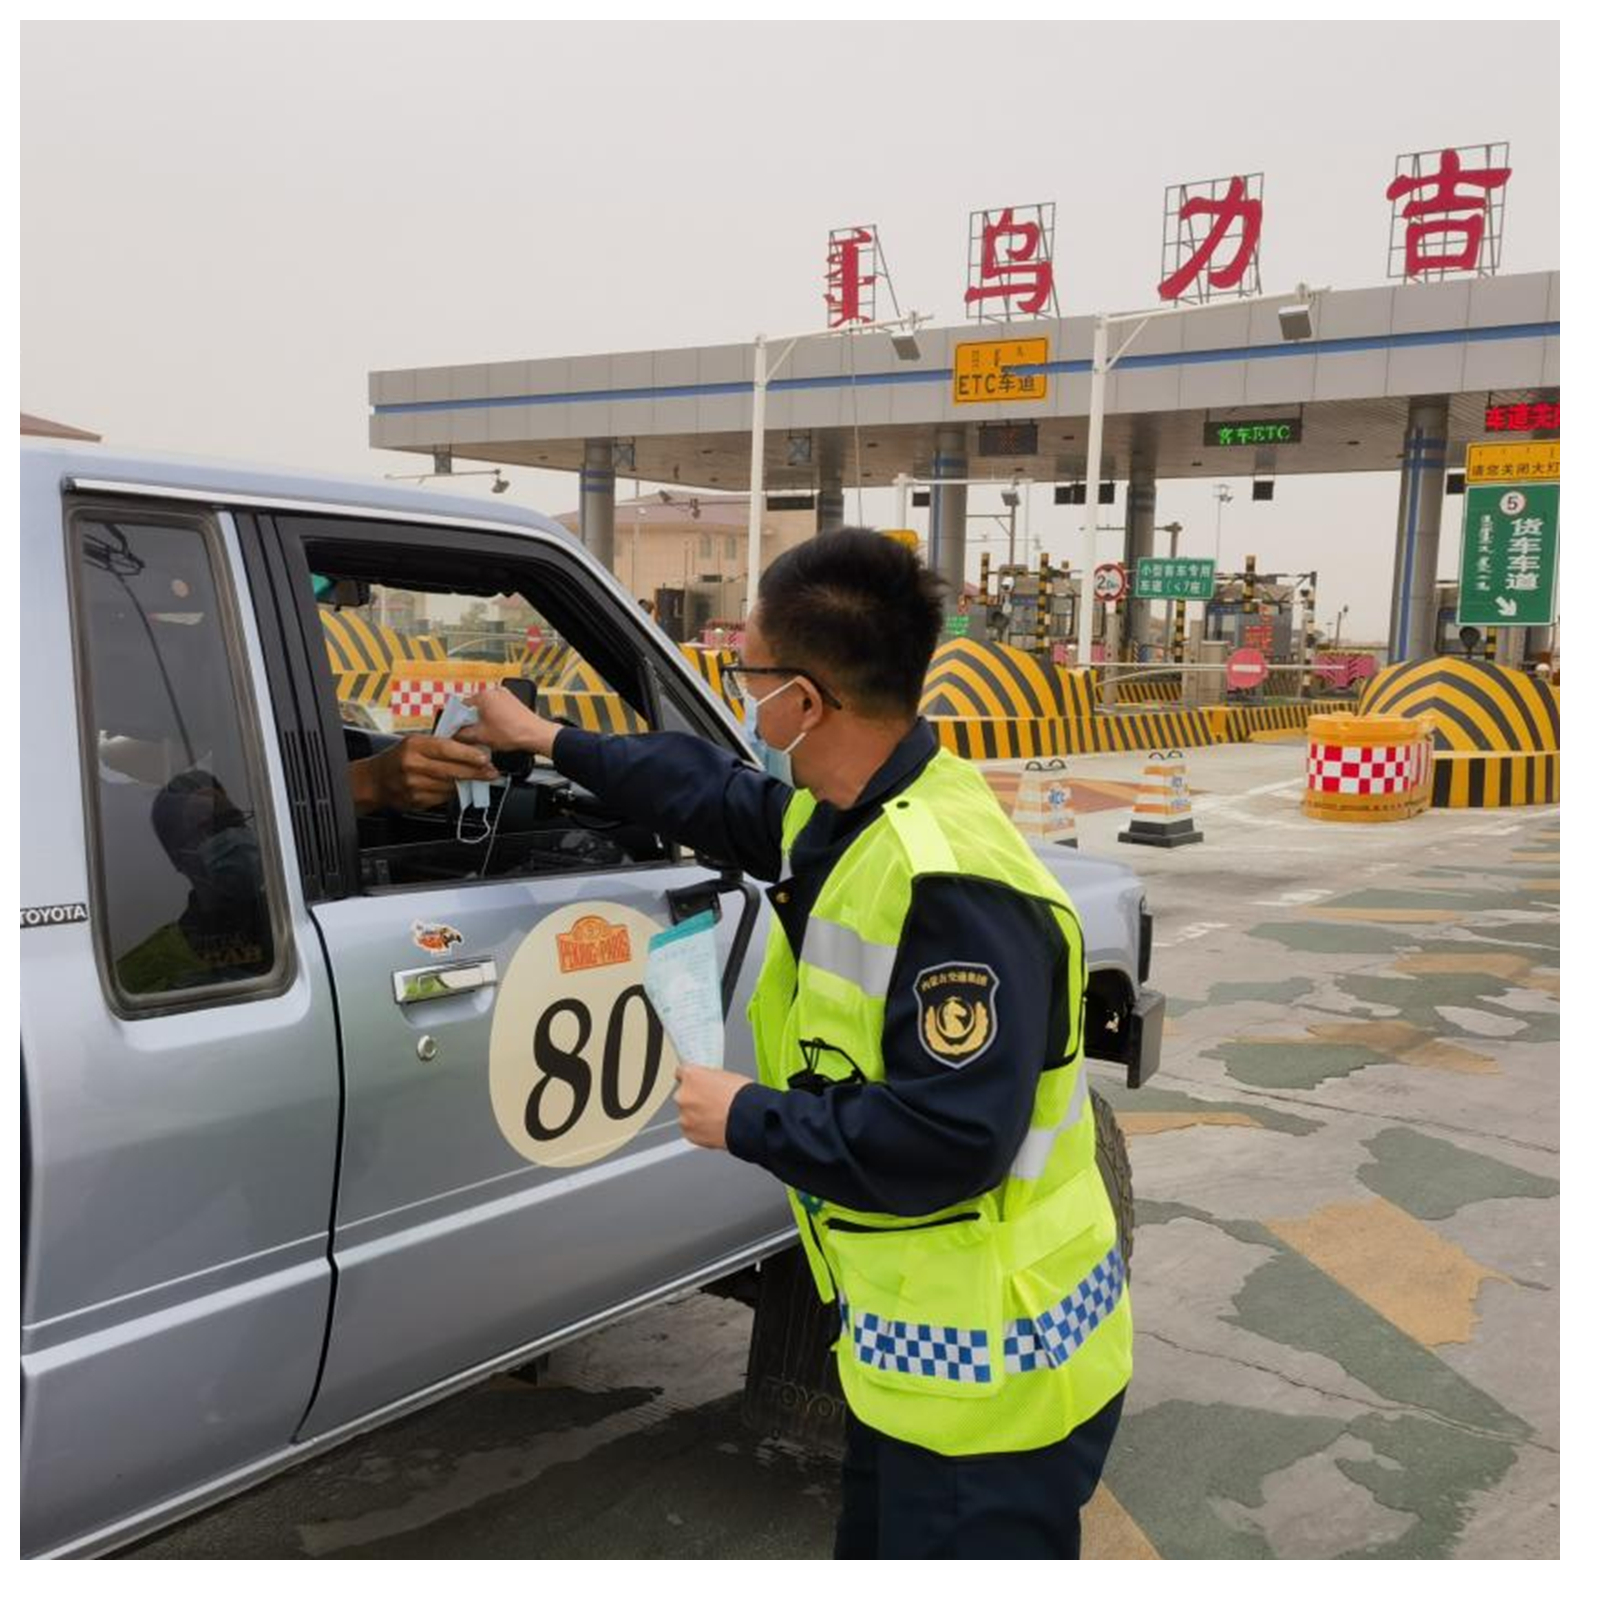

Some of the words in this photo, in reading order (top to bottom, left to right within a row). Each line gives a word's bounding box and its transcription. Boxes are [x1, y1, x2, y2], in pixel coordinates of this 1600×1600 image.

[1472, 462, 1559, 477] 请您关闭大灯
[1506, 496, 1519, 510] 5
[1505, 517, 1544, 590] 货车车道
[20, 903, 87, 926] TOYOTA
[525, 984, 664, 1142] 80
